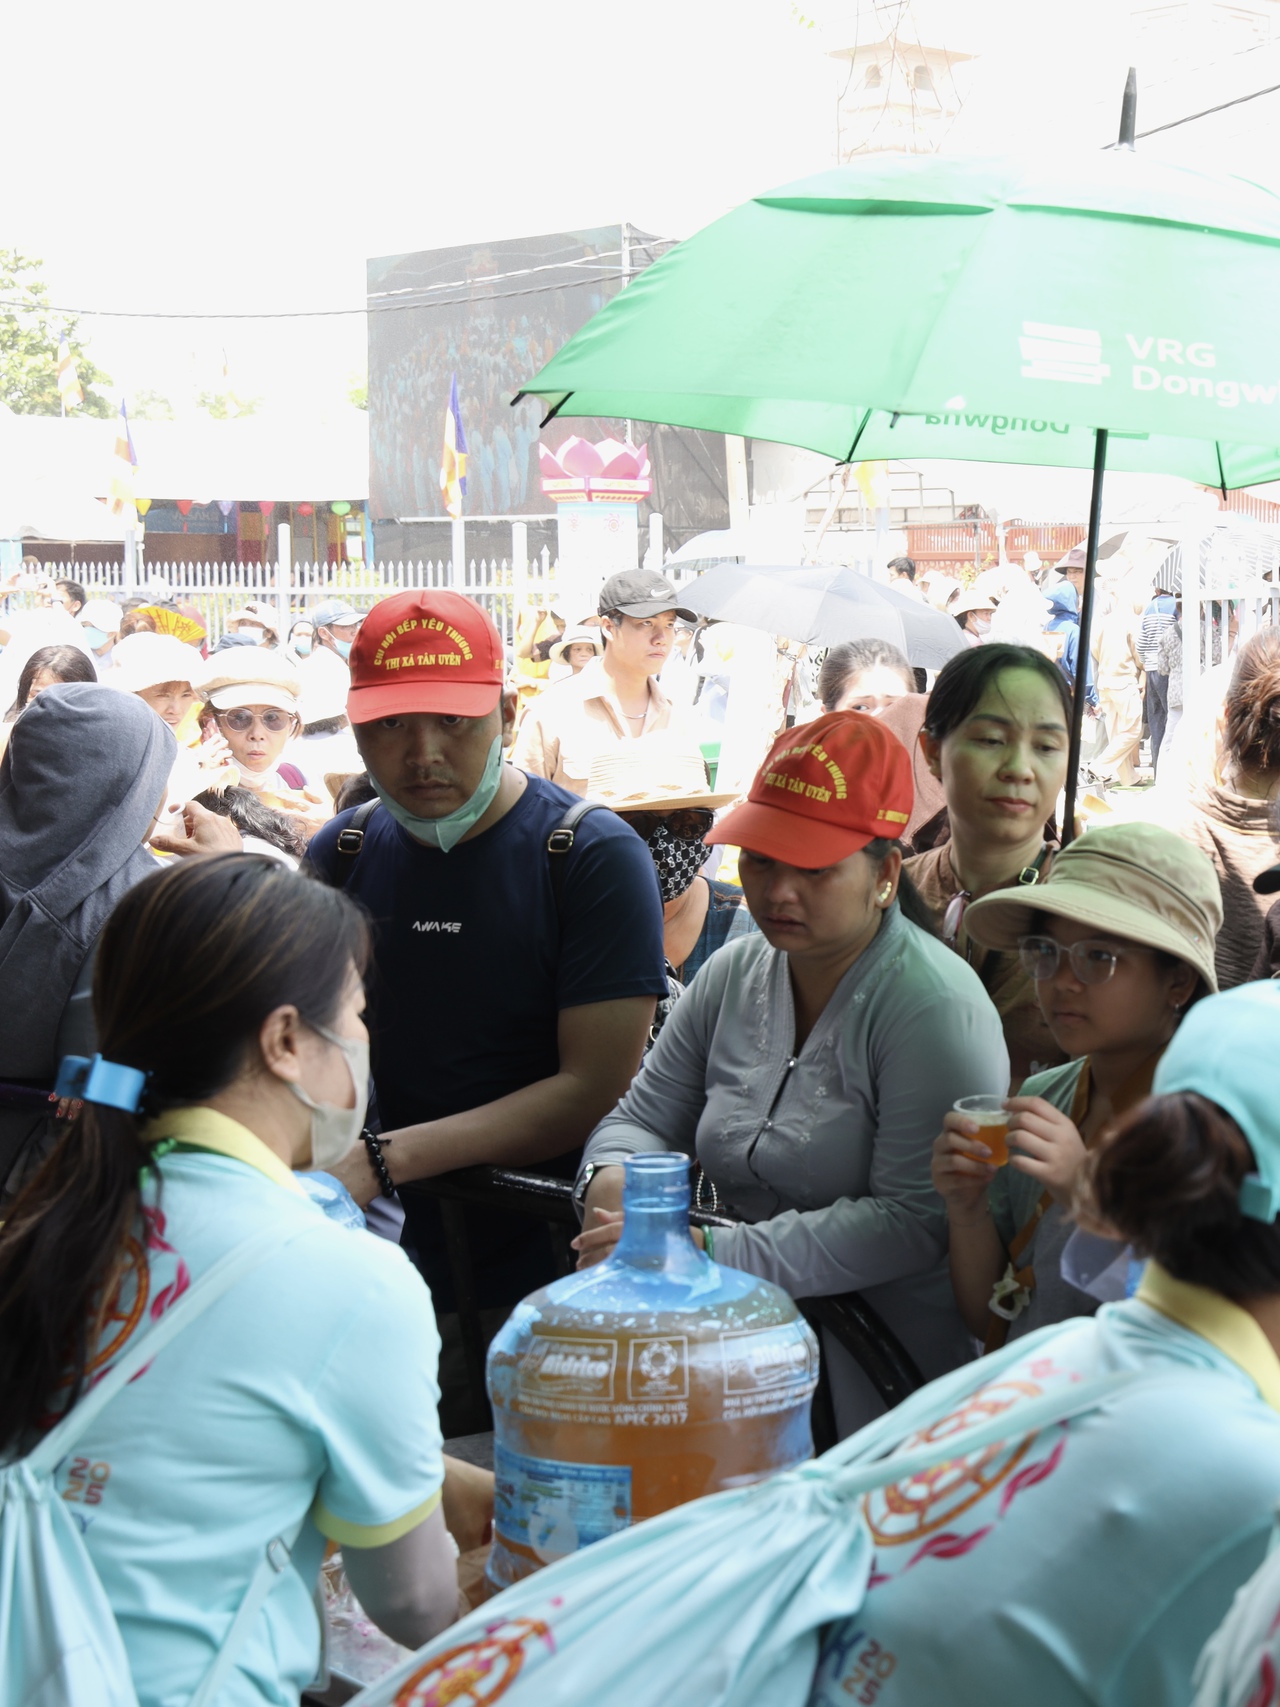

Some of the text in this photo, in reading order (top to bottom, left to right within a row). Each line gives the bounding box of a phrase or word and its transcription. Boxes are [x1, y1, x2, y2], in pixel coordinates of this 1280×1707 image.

[1125, 333, 1217, 368] VRG
[381, 631, 397, 649] HỘI
[397, 619, 418, 636] BẾP
[421, 618, 444, 631] YÊU
[445, 625, 474, 661] THƯƠNG
[385, 652, 461, 671] THỊ XÃ TÂN UYÊN
[788, 777, 806, 794] TÂN
[805, 785, 832, 803] UYÊN
[825, 760, 848, 800] THƯƠNG
[614, 1412, 649, 1426] APEC
[653, 1411, 688, 1426] 2017
[69, 1457, 111, 1483] 20
[62, 1480, 105, 1506] 25
[859, 1639, 896, 1679] 20
[842, 1665, 882, 1707] 25
